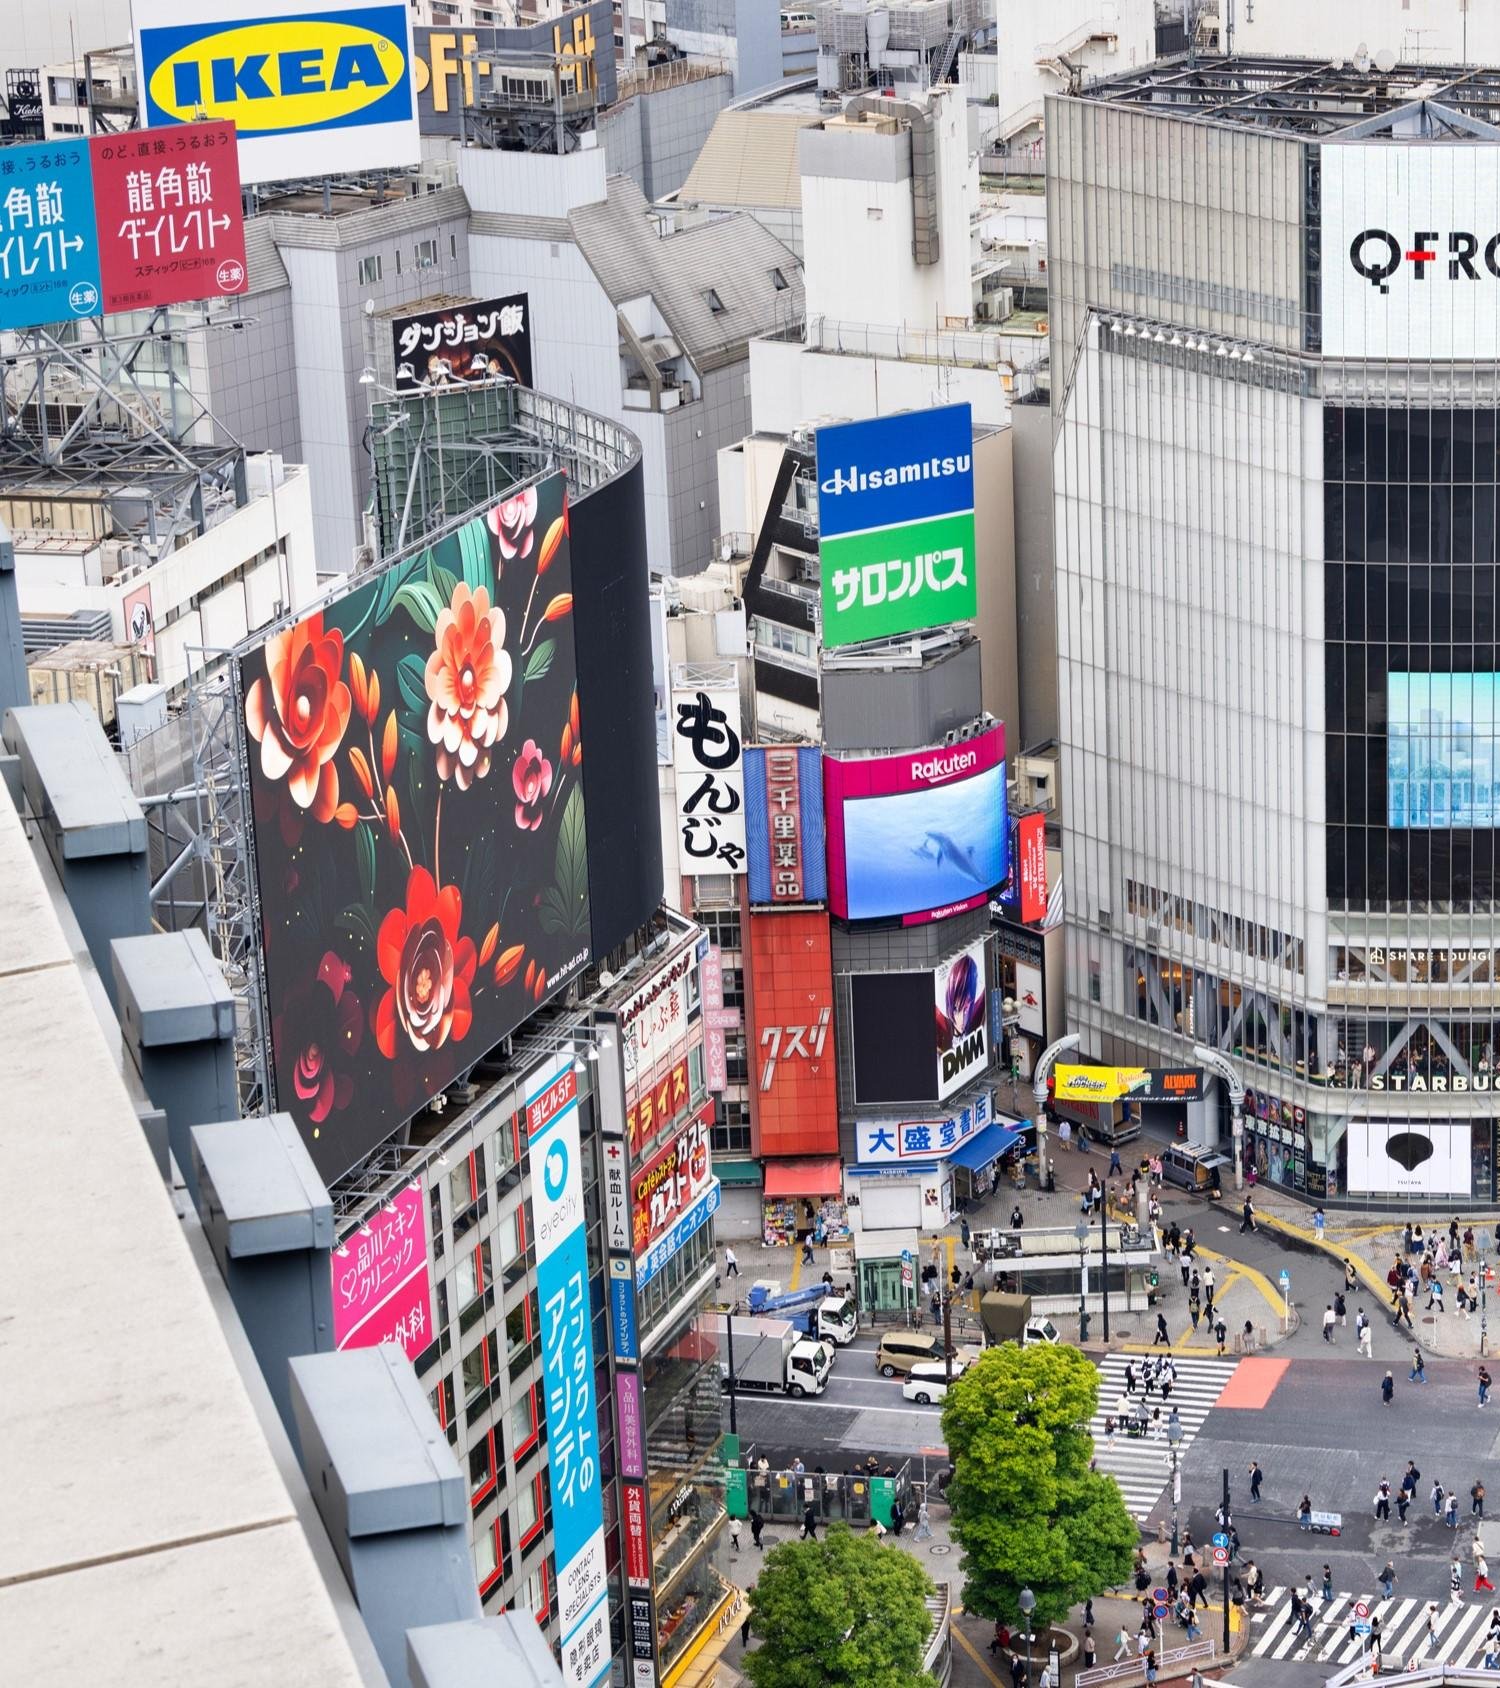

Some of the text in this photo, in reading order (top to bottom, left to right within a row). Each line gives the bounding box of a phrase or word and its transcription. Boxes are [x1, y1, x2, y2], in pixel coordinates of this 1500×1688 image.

[173, 43, 389, 109] IKEA
[0, 181, 65, 232] 角散
[126, 161, 213, 213] 龍角散
[118, 208, 231, 260] ダイレクト
[219, 267, 242, 284] 生薬
[398, 304, 525, 357] ダンジョン飯
[821, 453, 971, 496] Hisamitsu
[831, 546, 967, 612] サロンパス
[676, 691, 746, 870] もんじゃ
[911, 749, 977, 782] Rakuten
[769, 754, 800, 898] 三千里薬品
[1389, 951, 1491, 962] SHARE LOUNG
[760, 1007, 831, 1092] クスリ
[942, 1027, 984, 1083] DMM
[530, 1078, 573, 1130] 当ビル5F
[868, 1095, 986, 1154] 大盛堂書店
[539, 1191, 578, 1241] eyecity
[609, 1168, 624, 1236] 献血ルーム
[650, 1172, 687, 1232] ガスト
[357, 1203, 418, 1276] 品川スキン
[613, 1239, 625, 1248] 6F
[650, 1206, 706, 1273] 英会話イーオン
[360, 1237, 414, 1305] クリニック
[545, 1289, 577, 1509] アイシティ
[568, 1270, 596, 1492] コンタクトの
[622, 1392, 639, 1460] 品川美容外科
[625, 1464, 640, 1474] 4F
[627, 1487, 641, 1538] 外貨両替
[568, 1548, 595, 1587] CONTACT
[575, 1570, 590, 1594] LENS
[565, 1571, 601, 1621] SPECIALISTS
